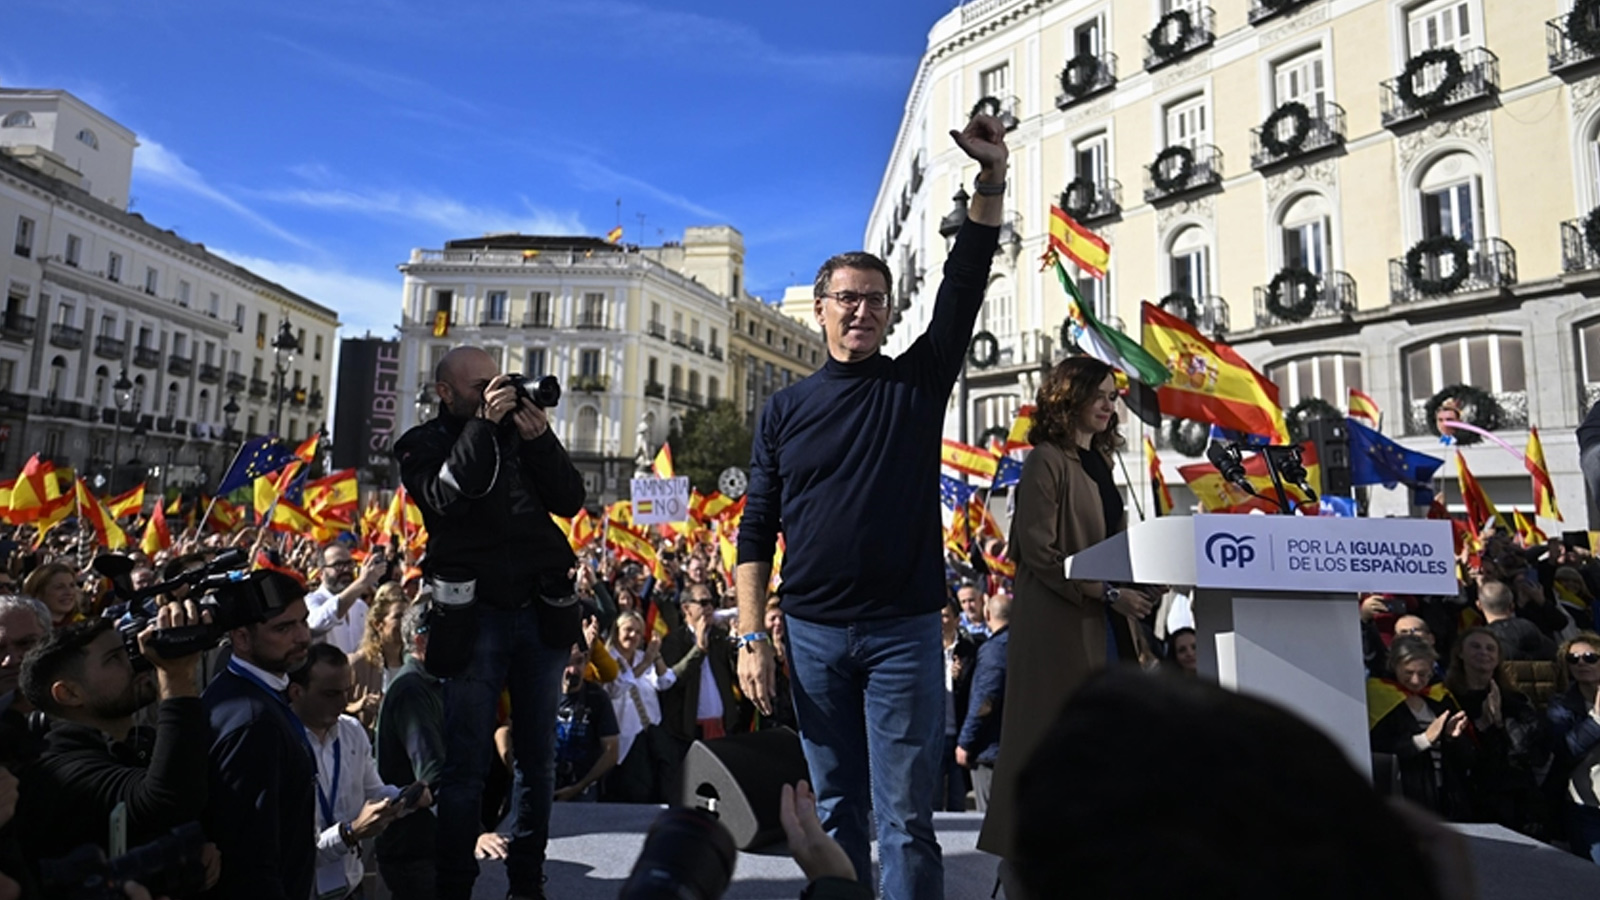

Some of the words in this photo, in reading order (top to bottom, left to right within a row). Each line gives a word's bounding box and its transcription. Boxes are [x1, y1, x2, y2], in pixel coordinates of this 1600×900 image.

[366, 346, 399, 450] SÚBETE
[655, 498, 679, 516] NO
[1287, 539, 1321, 554] POR
[1325, 540, 1347, 555] LA
[1350, 541, 1434, 557] IGUALDAD
[1289, 557, 1311, 571] DE
[1316, 557, 1347, 572] LOS
[1350, 556, 1447, 574] ESPAÑOLES
